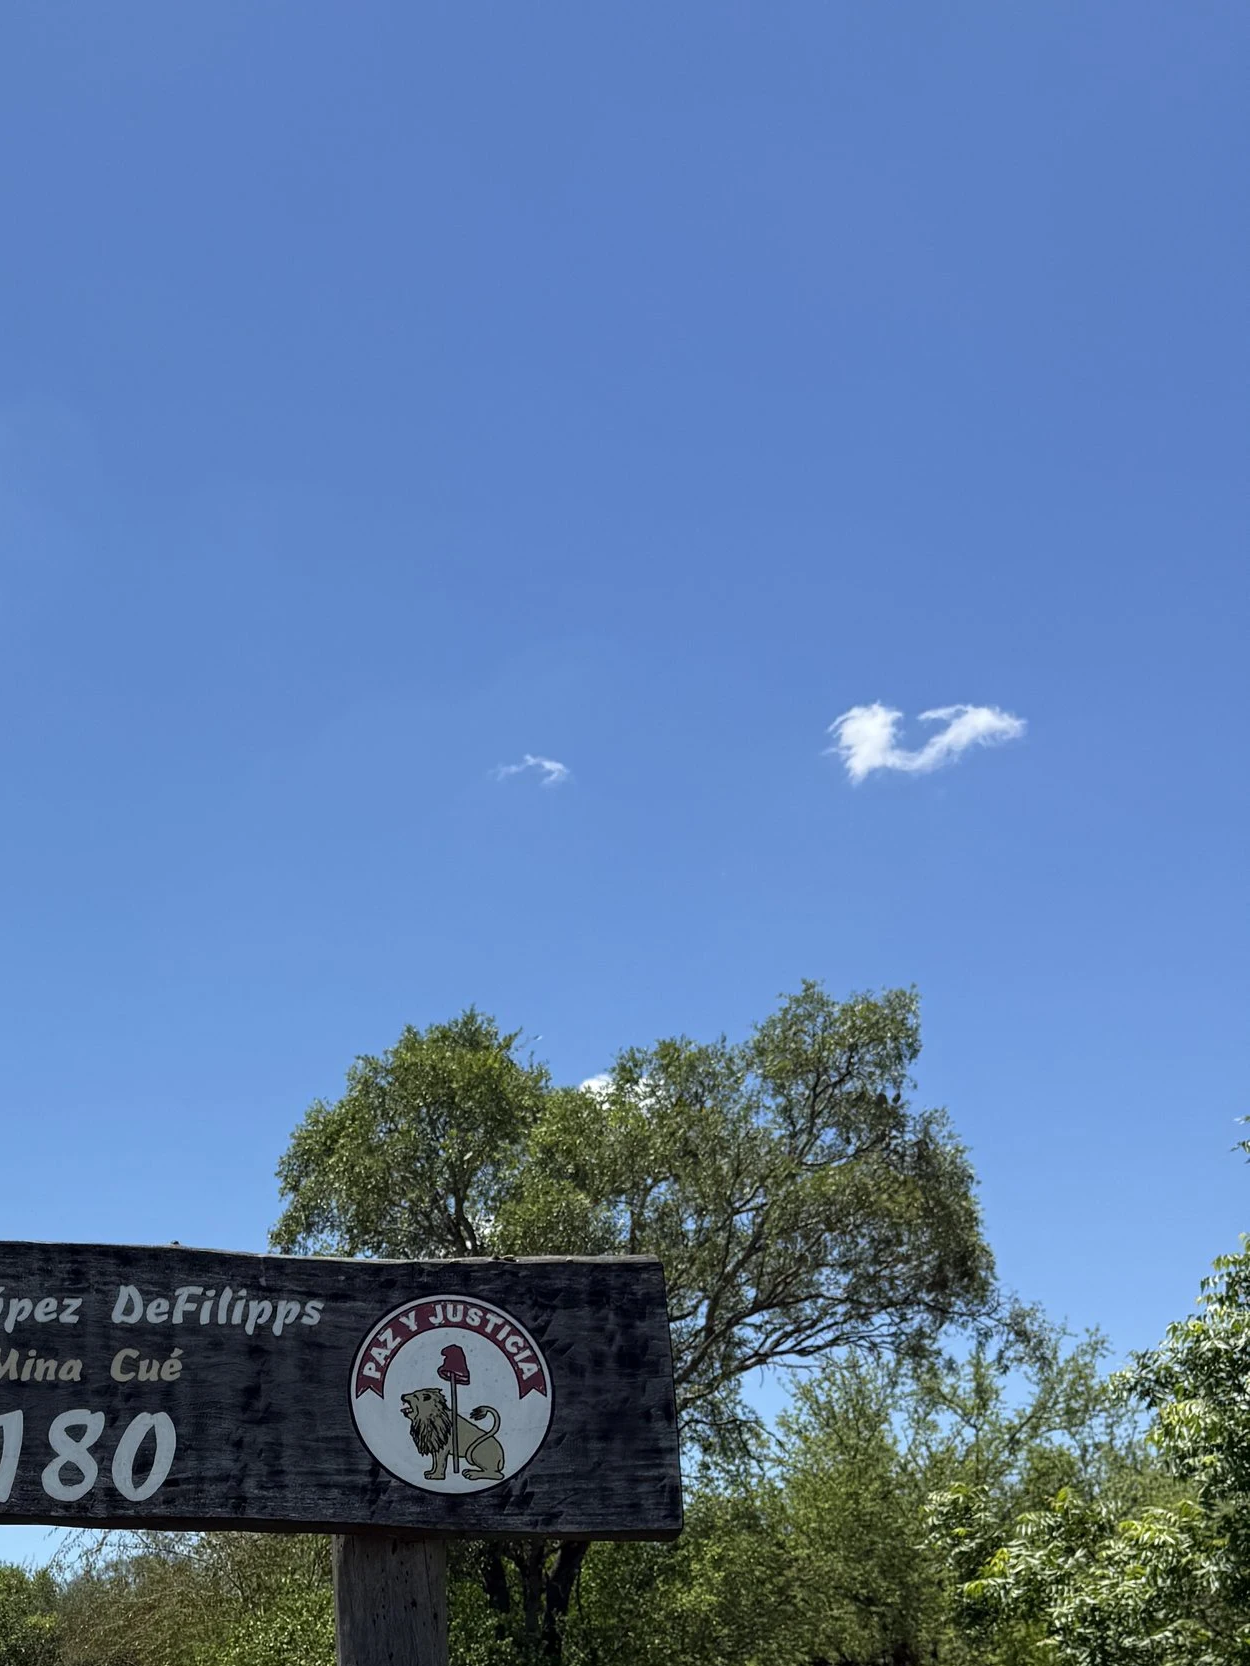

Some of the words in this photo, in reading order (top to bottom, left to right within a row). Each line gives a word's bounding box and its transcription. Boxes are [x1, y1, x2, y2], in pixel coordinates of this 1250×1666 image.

[111, 1284, 324, 1336] DeFilipps
[110, 1347, 184, 1382] Cué
[362, 1327, 402, 1380] PAZ
[398, 1311, 417, 1331] Y
[428, 1304, 540, 1381] JUSTICIA
